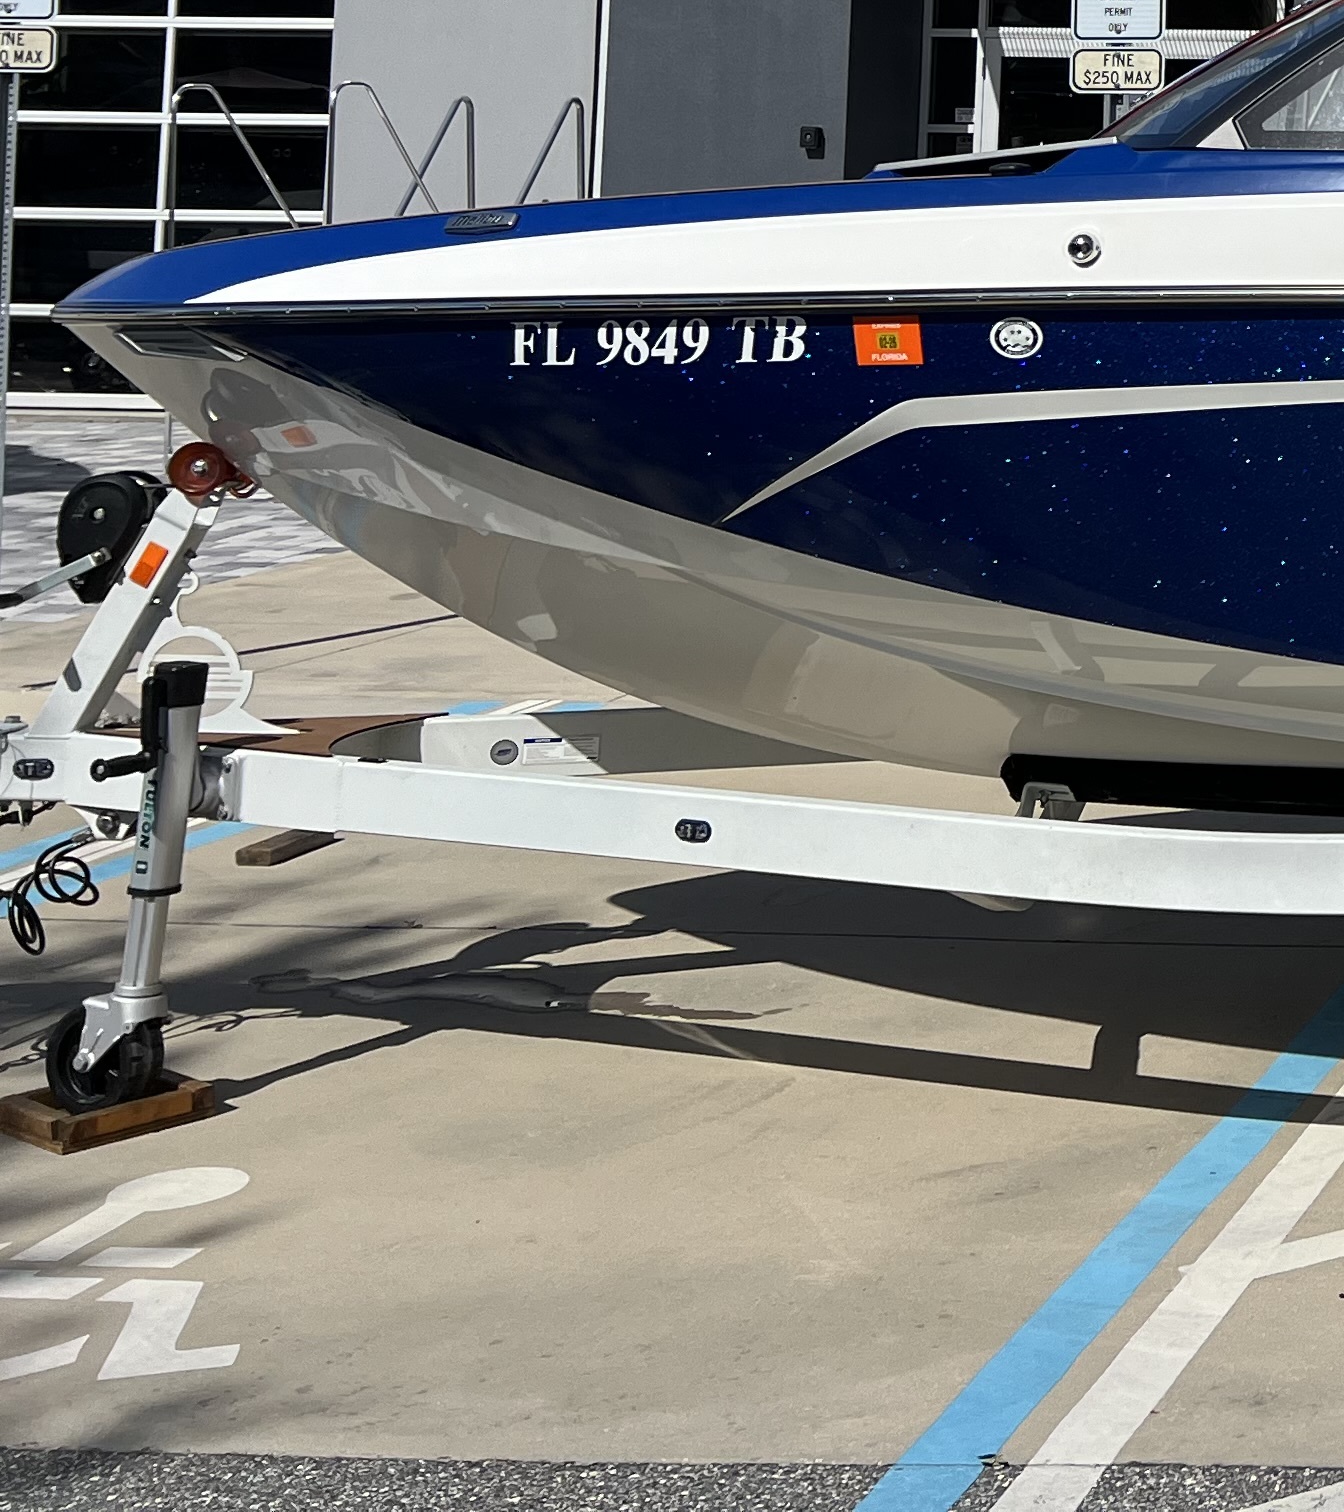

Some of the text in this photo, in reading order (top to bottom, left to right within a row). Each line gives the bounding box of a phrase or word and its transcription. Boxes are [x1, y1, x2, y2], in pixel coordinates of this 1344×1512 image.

[1104, 7, 1133, 17] PERMIT
[13, 50, 43, 64] MAX
[1103, 53, 1135, 68] FINE
[1083, 69, 1152, 86] $250 MAX
[510, 315, 808, 366] FL 9849 TB
